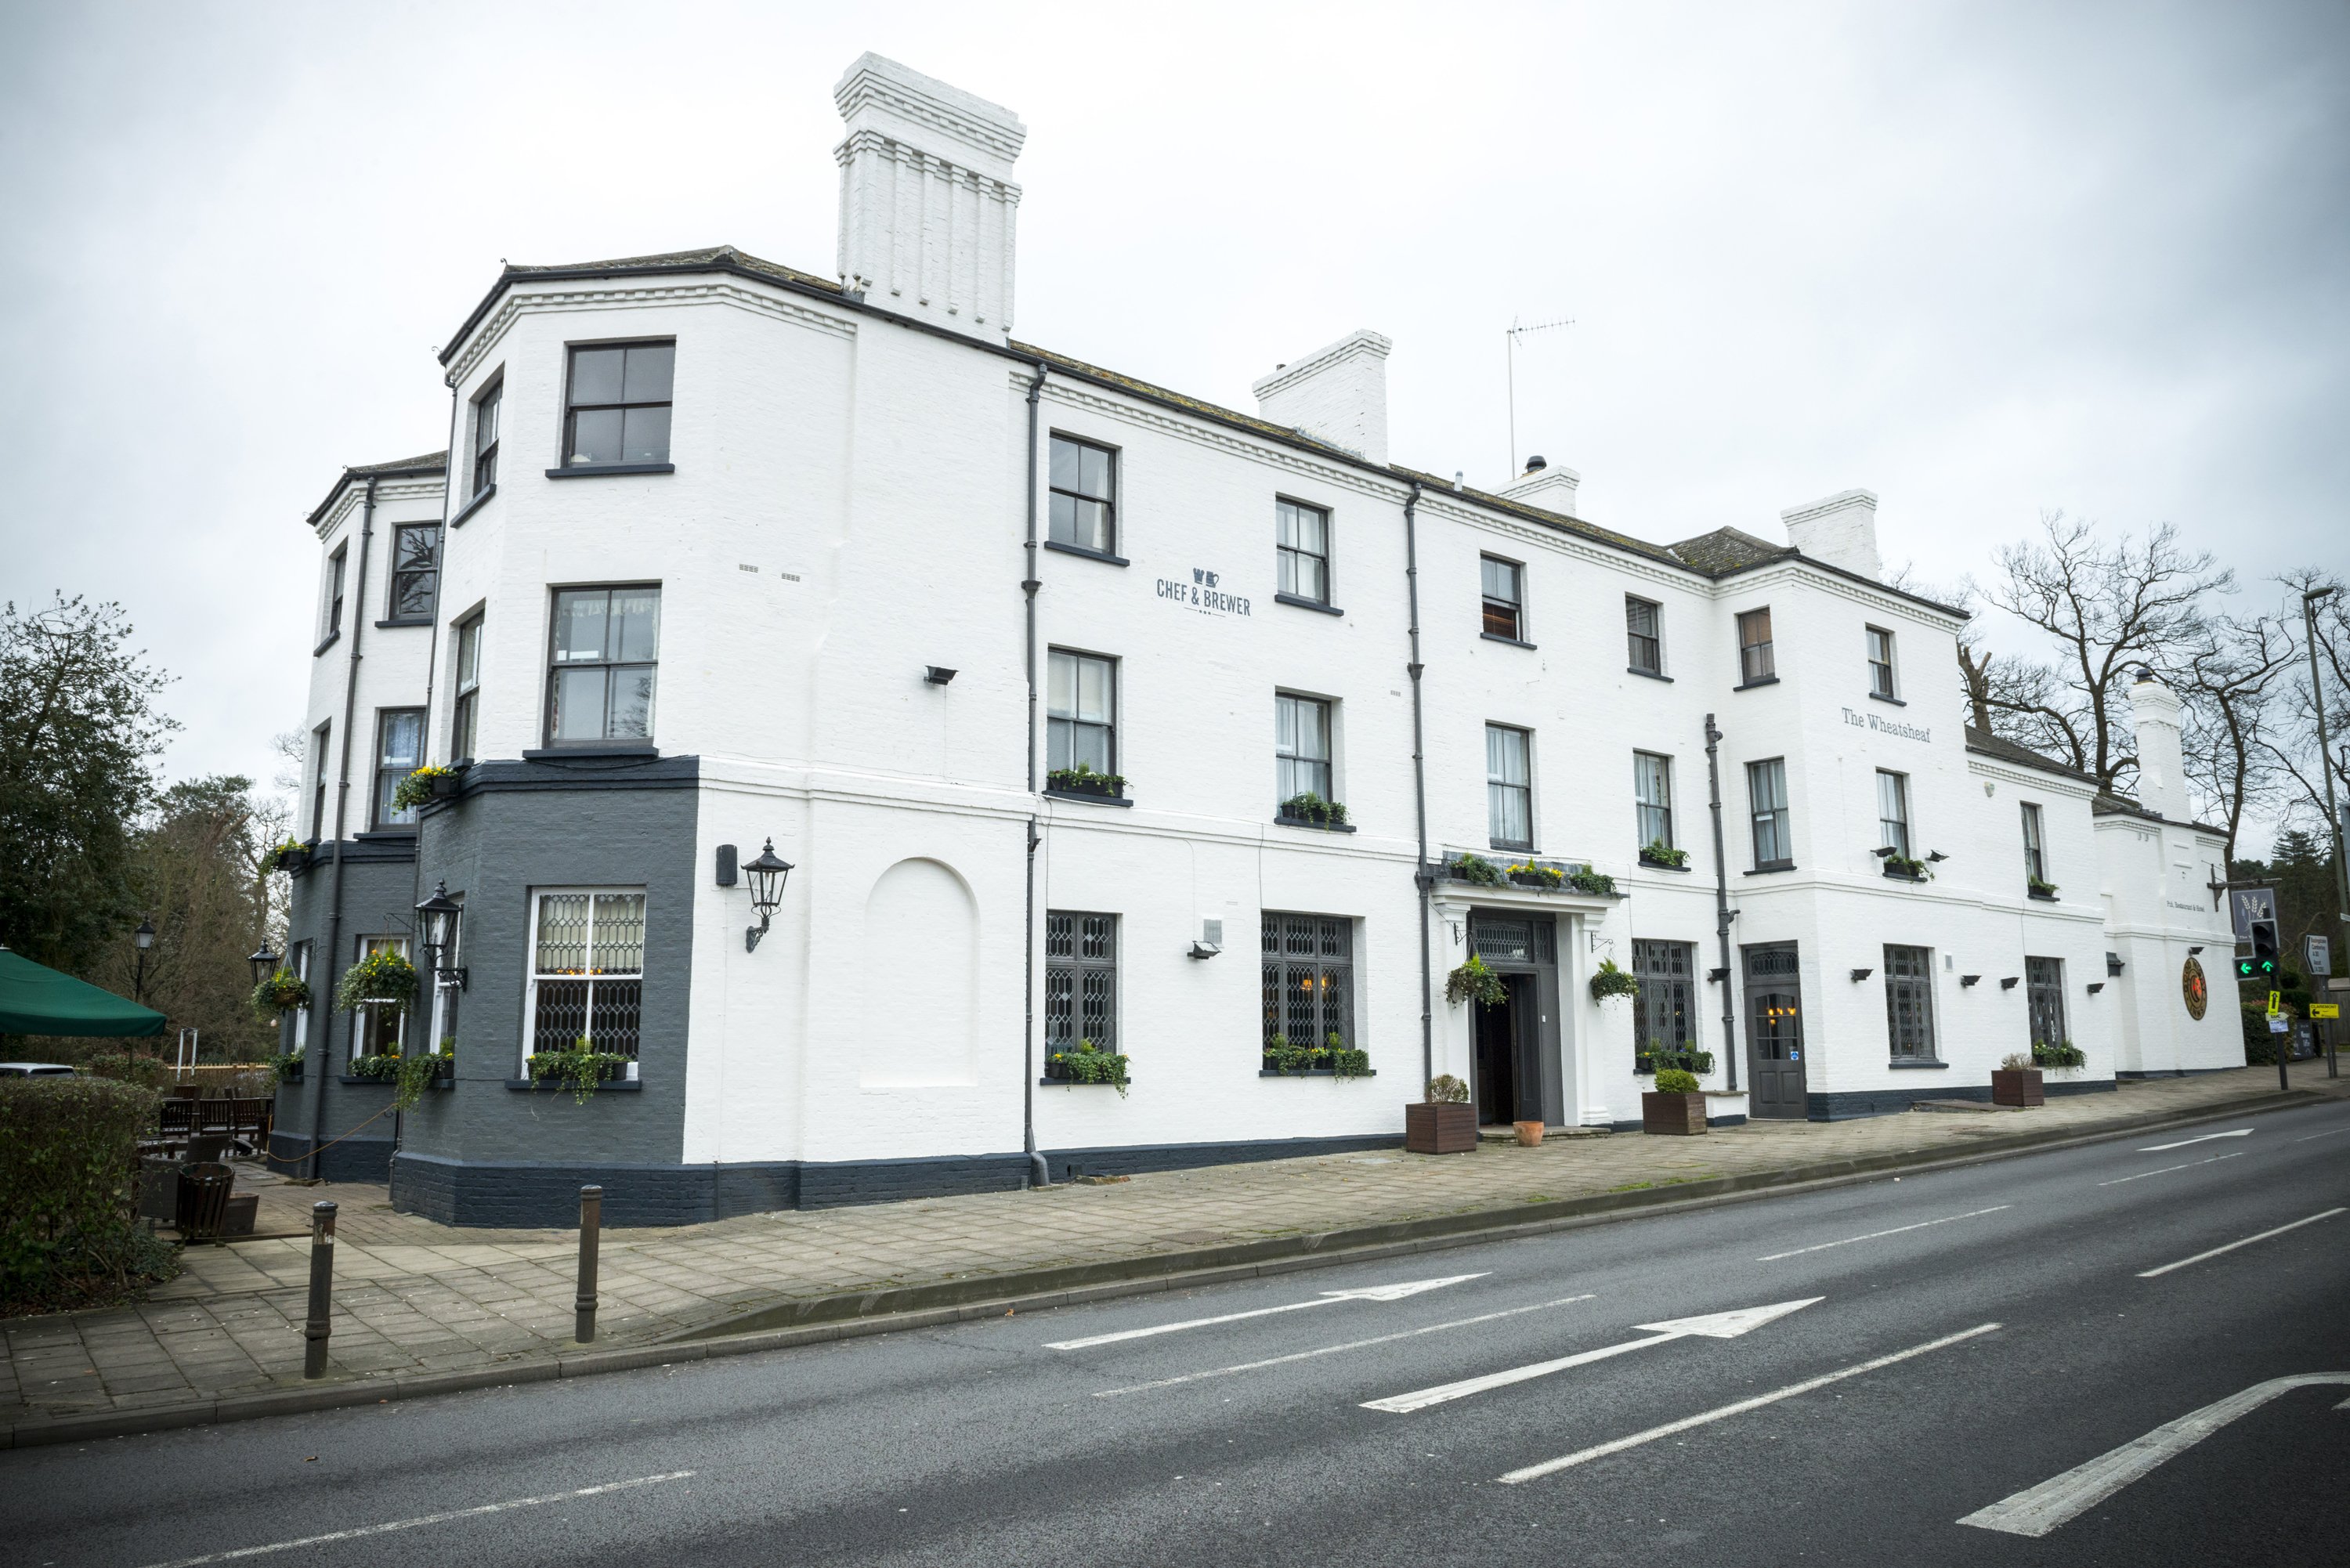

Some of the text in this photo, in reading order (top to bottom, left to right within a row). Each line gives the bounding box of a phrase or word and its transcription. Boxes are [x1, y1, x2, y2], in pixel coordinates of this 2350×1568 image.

[1156, 579, 1251, 616] CHEF & BREWER
[1842, 707, 1931, 743] The Wheatsheaf
